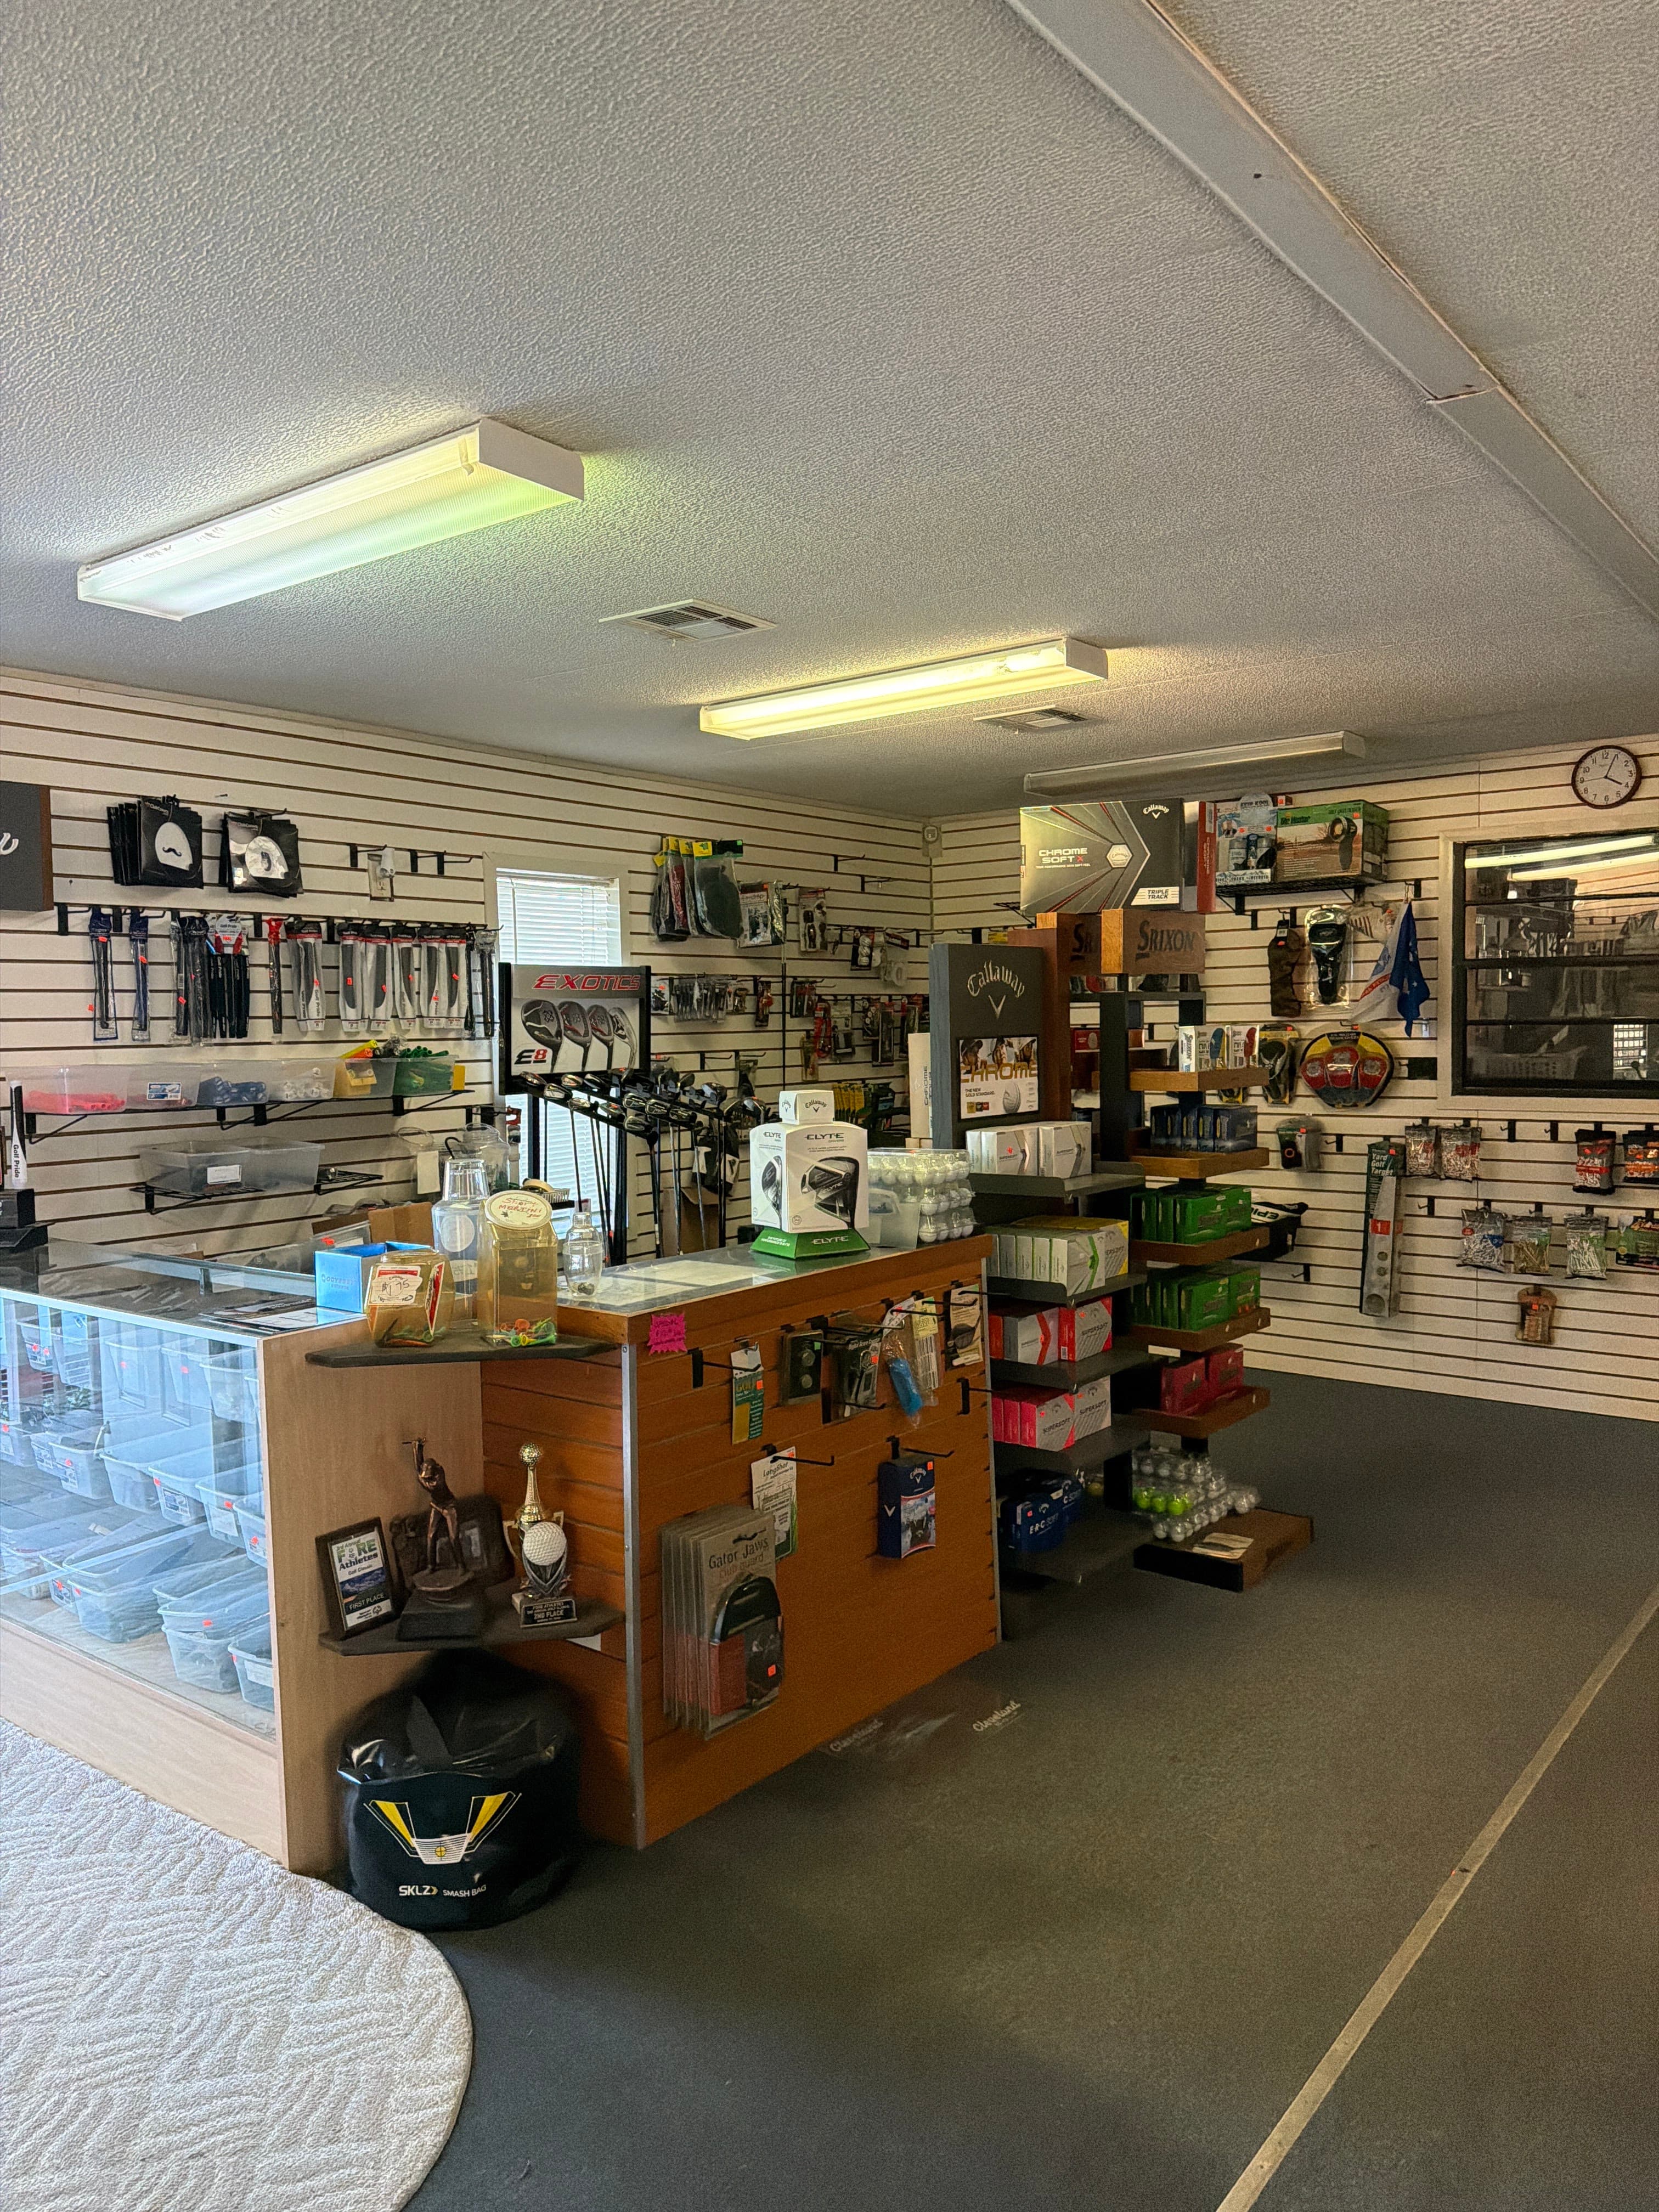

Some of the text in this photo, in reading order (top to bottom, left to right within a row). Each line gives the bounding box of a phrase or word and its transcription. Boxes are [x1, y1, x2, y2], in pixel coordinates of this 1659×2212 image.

[1143, 803, 1170, 814] Callaway
[1039, 847, 1088, 856] CHROME
[1137, 920, 1195, 952] SRIXON
[532, 973, 641, 991] EXOTICS
[967, 960, 1025, 998] Callaway
[514, 1048, 548, 1065] E8
[960, 1062, 1038, 1084] CHROME
[804, 1099, 827, 1109] Callaway
[1371, 1160, 1386, 1168] Golf
[1372, 1167, 1393, 1176] Target
[1251, 1207, 1279, 1220] EPI
[1376, 1221, 1381, 1232] 1
[811, 1235, 849, 1245] ELYTE
[1079, 1400, 1107, 1415] SUPERSOFT
[1043, 1417, 1071, 1434] SUPERSOFT
[763, 1461, 789, 1477] LongShot
[339, 1551, 379, 1571] Athletes
[709, 1538, 769, 1569] Gator Jaws
[348, 1593, 385, 1611] FIRST PLACE
[972, 1700, 1022, 1733] Cleveland
[398, 1884, 487, 1898] SKLZ SMASH BAG
